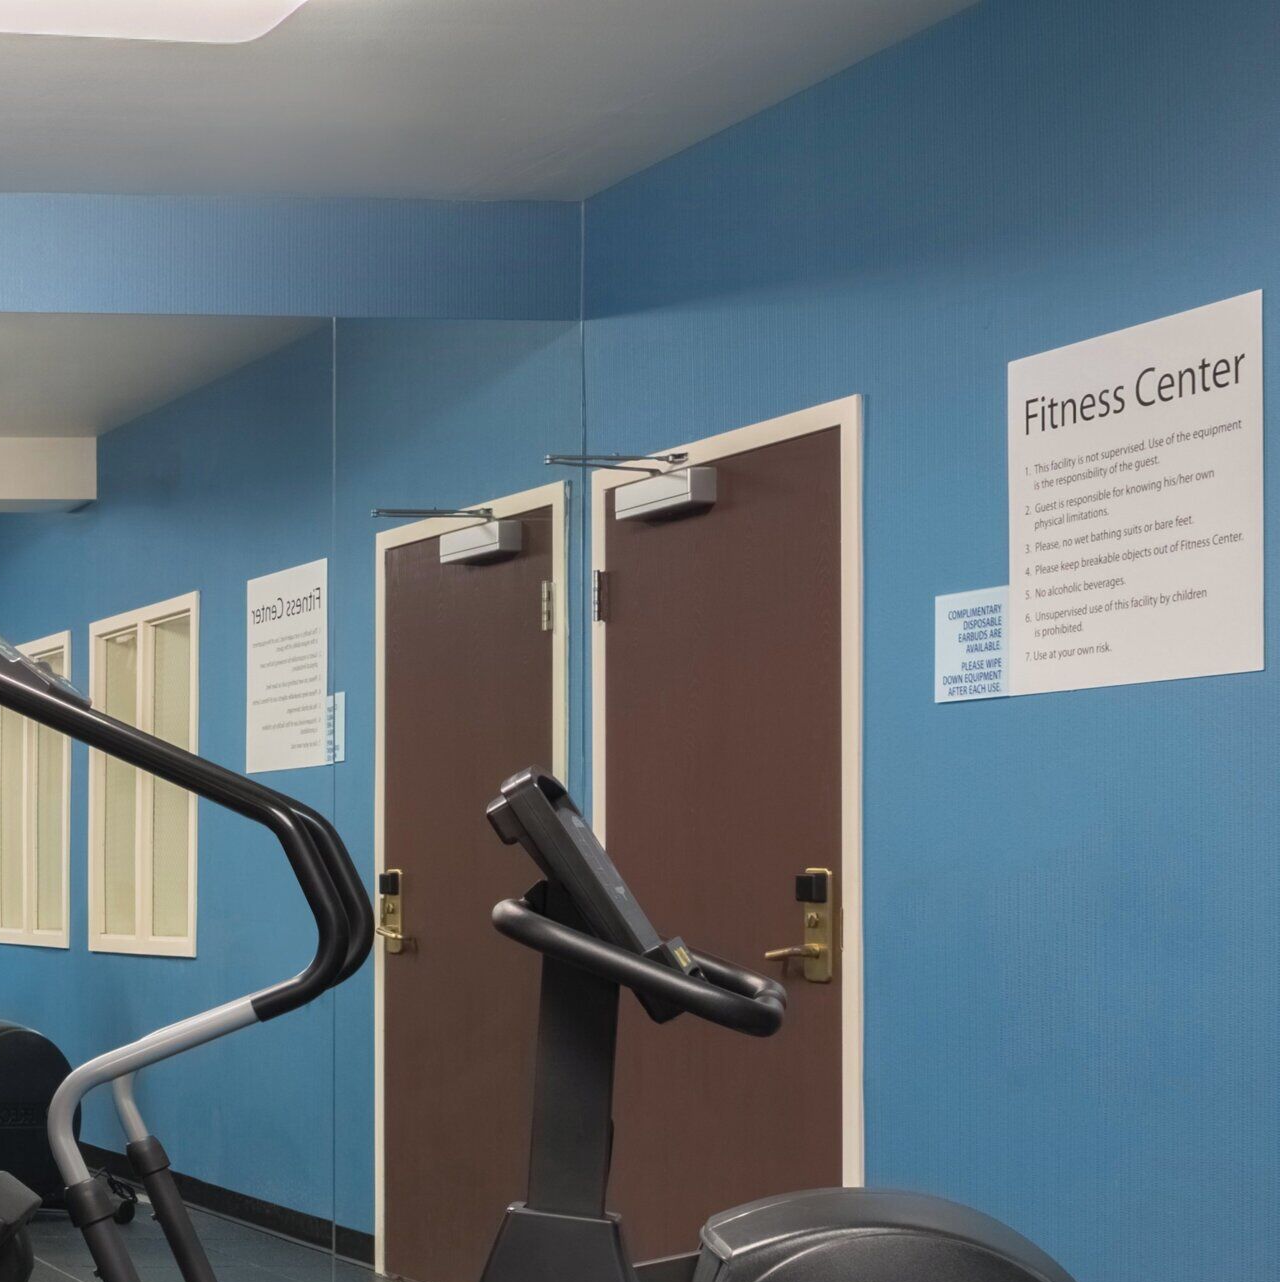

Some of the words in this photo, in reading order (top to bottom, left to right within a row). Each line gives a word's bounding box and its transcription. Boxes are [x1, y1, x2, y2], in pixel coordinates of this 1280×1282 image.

[1025, 385, 1125, 435] Fitness
[1135, 353, 1245, 406] Center
[1033, 462, 1050, 474] This
[1050, 457, 1076, 470] facility
[1077, 454, 1084, 464] is
[1085, 451, 1099, 463] not
[1100, 439, 1146, 460] supervised.
[1148, 437, 1164, 449] Use
[1165, 432, 1175, 445] of
[1176, 431, 1191, 443] the
[1192, 419, 1242, 439] equipment
[1033, 479, 1040, 490] is
[1040, 477, 1054, 488] the
[1055, 466, 1107, 486] responsibility
[1108, 461, 1118, 474] of
[1118, 460, 1133, 472] the
[1134, 455, 1159, 471] guest.
[1034, 500, 1057, 513] Guest
[1058, 498, 1064, 509] is
[1065, 488, 1111, 507] responsible
[1112, 486, 1124, 497] for
[1125, 480, 1162, 495] knowing
[1163, 473, 1193, 487] his/her
[1195, 469, 1214, 481] own
[1033, 513, 1064, 531] physical
[1066, 507, 1109, 523] limitations.
[1061, 538, 1073, 547] no
[1073, 534, 1089, 544] wet
[1090, 528, 1121, 542] bathing
[1123, 524, 1142, 536] suits
[1143, 523, 1153, 532] or
[1154, 519, 1173, 530] bare
[1174, 515, 1193, 526] feet.
[1034, 563, 1059, 575] Please
[1060, 560, 1079, 571] keep
[1080, 551, 1120, 567] breakable
[1121, 547, 1152, 561] objects
[1152, 544, 1168, 555] out
[1169, 540, 1179, 552] of
[1180, 537, 1210, 550] Fitness
[1211, 532, 1243, 545] Center.
[1034, 587, 1046, 598] No
[1047, 581, 1082, 596] alcoholic
[1083, 576, 1126, 590] beverages.
[947, 603, 1001, 620] COMPLIMENTARY
[1034, 603, 1087, 621] Unsupervised
[1088, 604, 1103, 614] use
[1104, 599, 1113, 612] of
[1114, 598, 1129, 610] this
[1130, 595, 1158, 607] facility
[1159, 592, 1171, 605] by
[1171, 588, 1207, 602] children
[963, 615, 1002, 630] DISPOSABLE
[1034, 627, 1041, 637] is
[1041, 620, 1083, 638] prohibited.
[958, 629, 988, 643] EARBUDS
[988, 627, 1001, 638] ARE
[1032, 650, 1047, 661] Use
[1048, 649, 1056, 659] at
[1057, 648, 1075, 660] your
[1076, 645, 1094, 655] own
[1095, 641, 1112, 653] risk.
[961, 659, 984, 671] PLEASE
[985, 657, 1001, 668] WIPE
[942, 674, 963, 685] DOWN
[964, 669, 1002, 683] EQUIPMENT
[947, 685, 967, 696] AFTER
[968, 683, 986, 694] EACH
